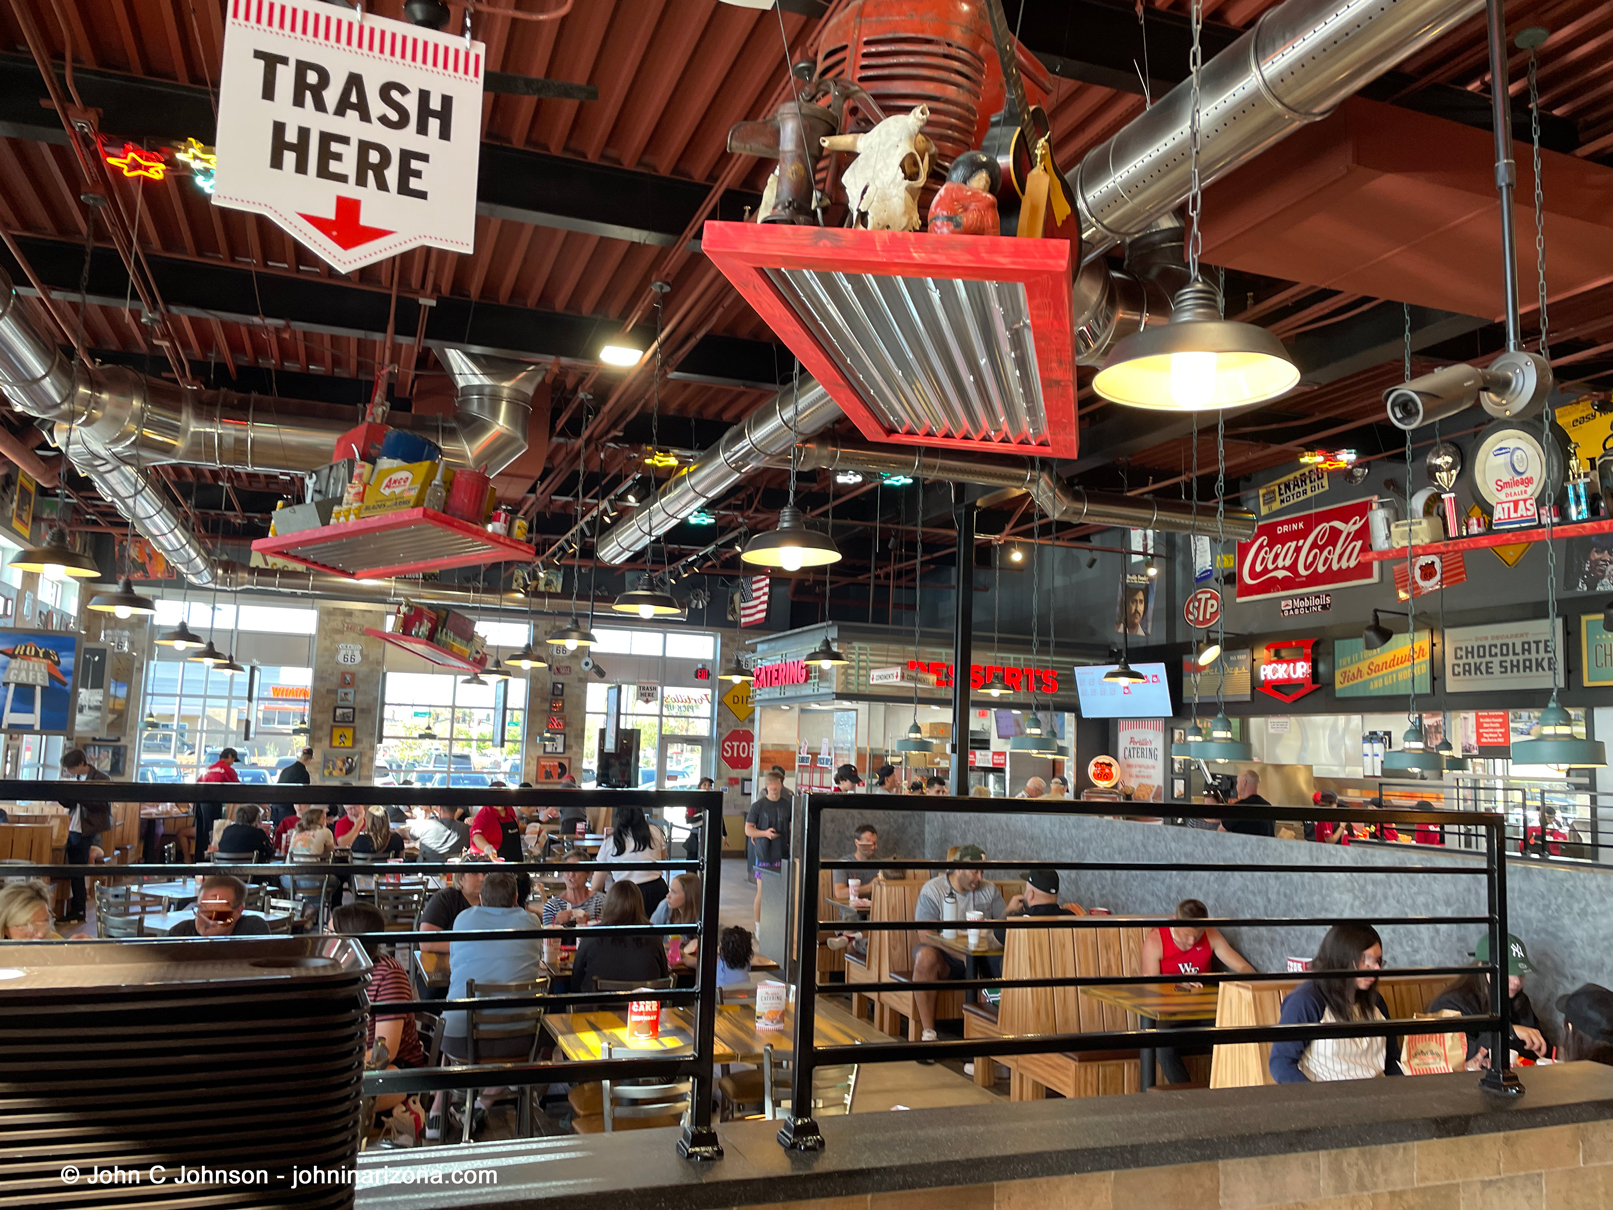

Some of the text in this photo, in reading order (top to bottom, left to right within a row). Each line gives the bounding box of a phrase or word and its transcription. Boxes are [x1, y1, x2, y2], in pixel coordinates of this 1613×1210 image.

[253, 48, 454, 142] TRASH
[269, 119, 430, 201] HERE
[1572, 410, 1597, 427] easy
[1495, 476, 1534, 492] Smileage
[1280, 488, 1307, 505] MOTOR
[1310, 481, 1325, 493] OIL
[1505, 489, 1528, 498] DEALER
[1495, 499, 1535, 520] ATLAS
[1277, 521, 1304, 534] DRINK
[1242, 515, 1368, 585] Coca-Cola
[1188, 592, 1218, 622] STP
[1293, 594, 1331, 609] Mobiloils
[1283, 605, 1323, 616] GASOLINE
[14, 644, 58, 661] ROY'S
[342, 653, 356, 663] 66
[554, 646, 567, 655] 66
[1454, 639, 1552, 660] CHOCOLATE
[10, 660, 47, 671] MOTEL
[1260, 662, 1288, 680] PICK
[1340, 645, 1427, 685] Fish Sandwich
[1452, 656, 1556, 677] CAKE SHAKE
[9, 669, 44, 683] CAFE
[697, 669, 708, 680] EXIT
[753, 659, 806, 689] CATERING
[1123, 746, 1158, 760] CATERING
